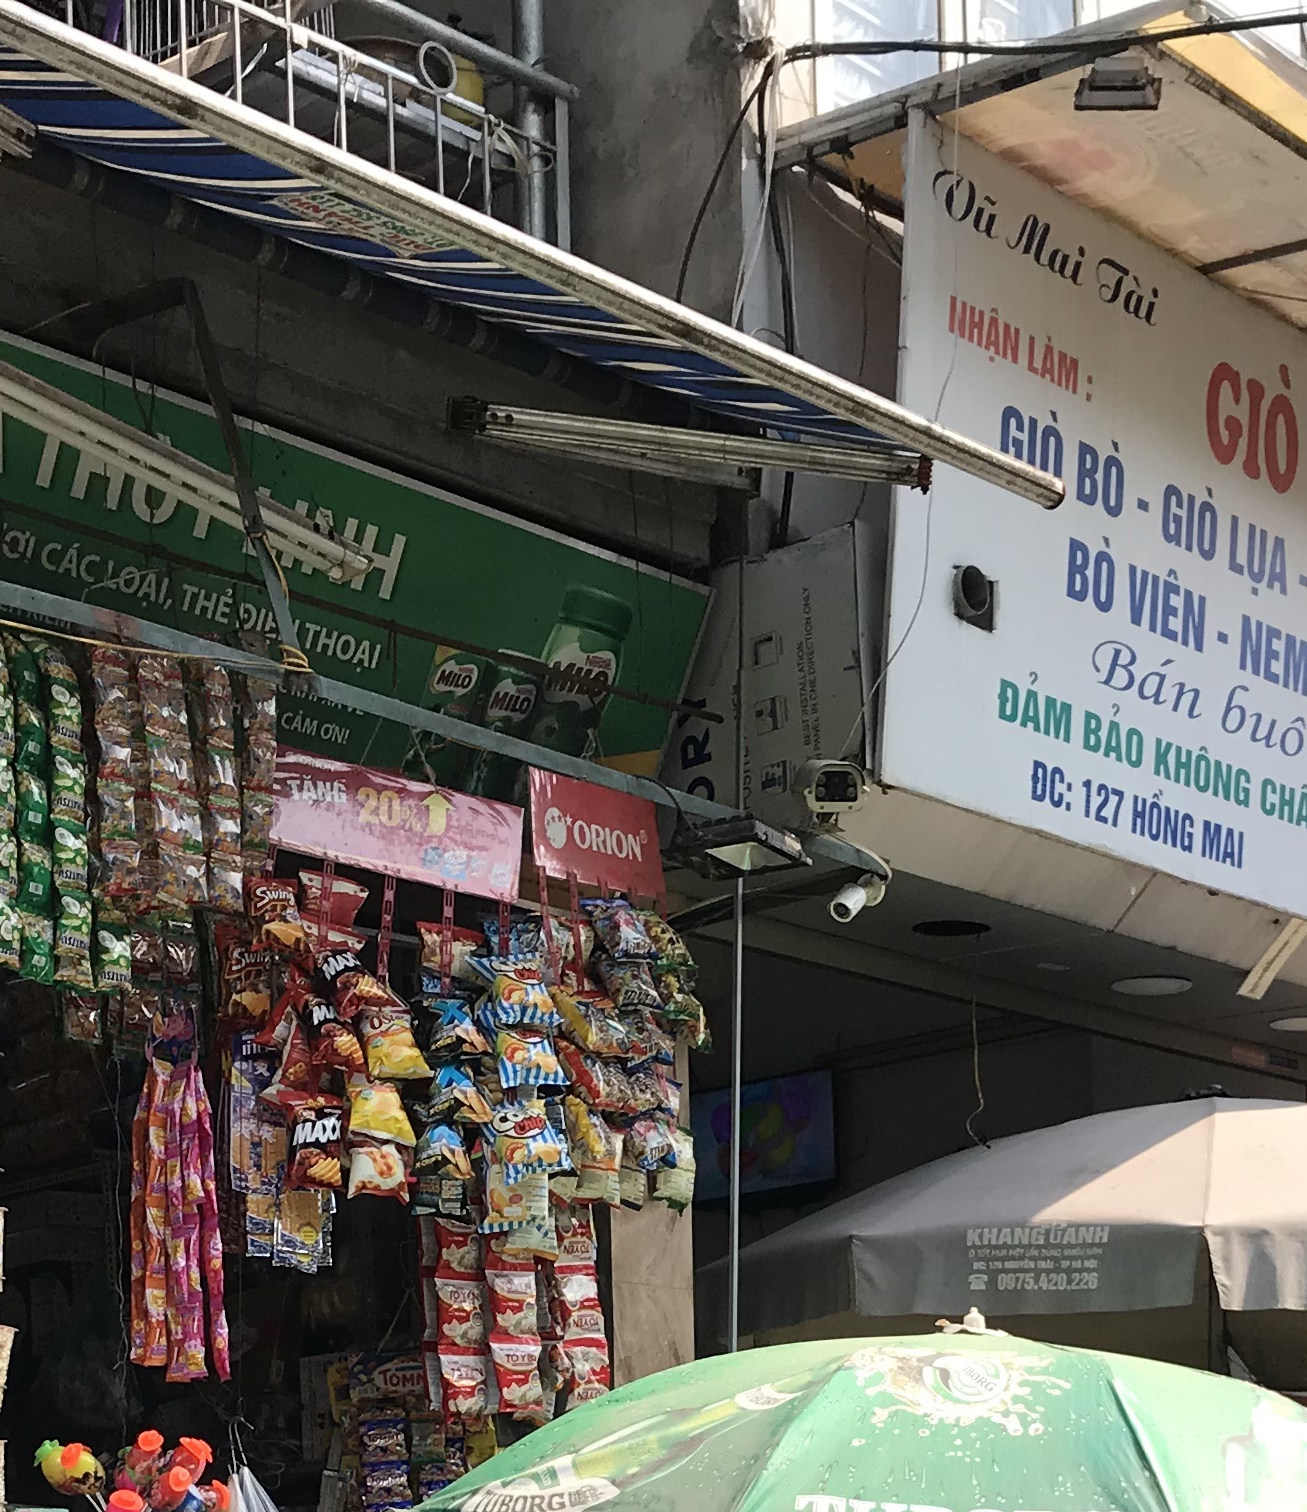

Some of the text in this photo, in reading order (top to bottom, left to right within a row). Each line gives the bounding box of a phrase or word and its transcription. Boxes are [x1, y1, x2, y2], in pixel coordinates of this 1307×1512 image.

[1005, 213, 1084, 286] Mai
[1096, 257, 1156, 326] Tài
[948, 295, 1080, 395] NHẬN LÀM
[1205, 361, 1299, 494] GIÒ
[1075, 440, 1125, 518] BÒ
[1162, 483, 1218, 562] GIÒ
[1228, 512, 1289, 599] LỤA
[41, 539, 100, 583] CÁC
[181, 581, 234, 626] THẺ
[303, 620, 384, 677] THOẠI
[1066, 535, 1115, 614] BÒ
[1127, 568, 1208, 655] VIÊN
[435, 671, 474, 692] MILO
[489, 690, 532, 716] MILO
[1091, 639, 1203, 721] Bán
[996, 671, 1074, 745] ĐẢM
[1082, 702, 1145, 771] BẢO
[1153, 736, 1252, 809] KHÔNG
[573, 823, 643, 862] ORION
[1030, 759, 1246, 870] ĐC: 127 HỒNG MAI
[966, 1227, 1046, 1246] KHANG
[997, 1271, 1099, 1291] 0975.420.226
